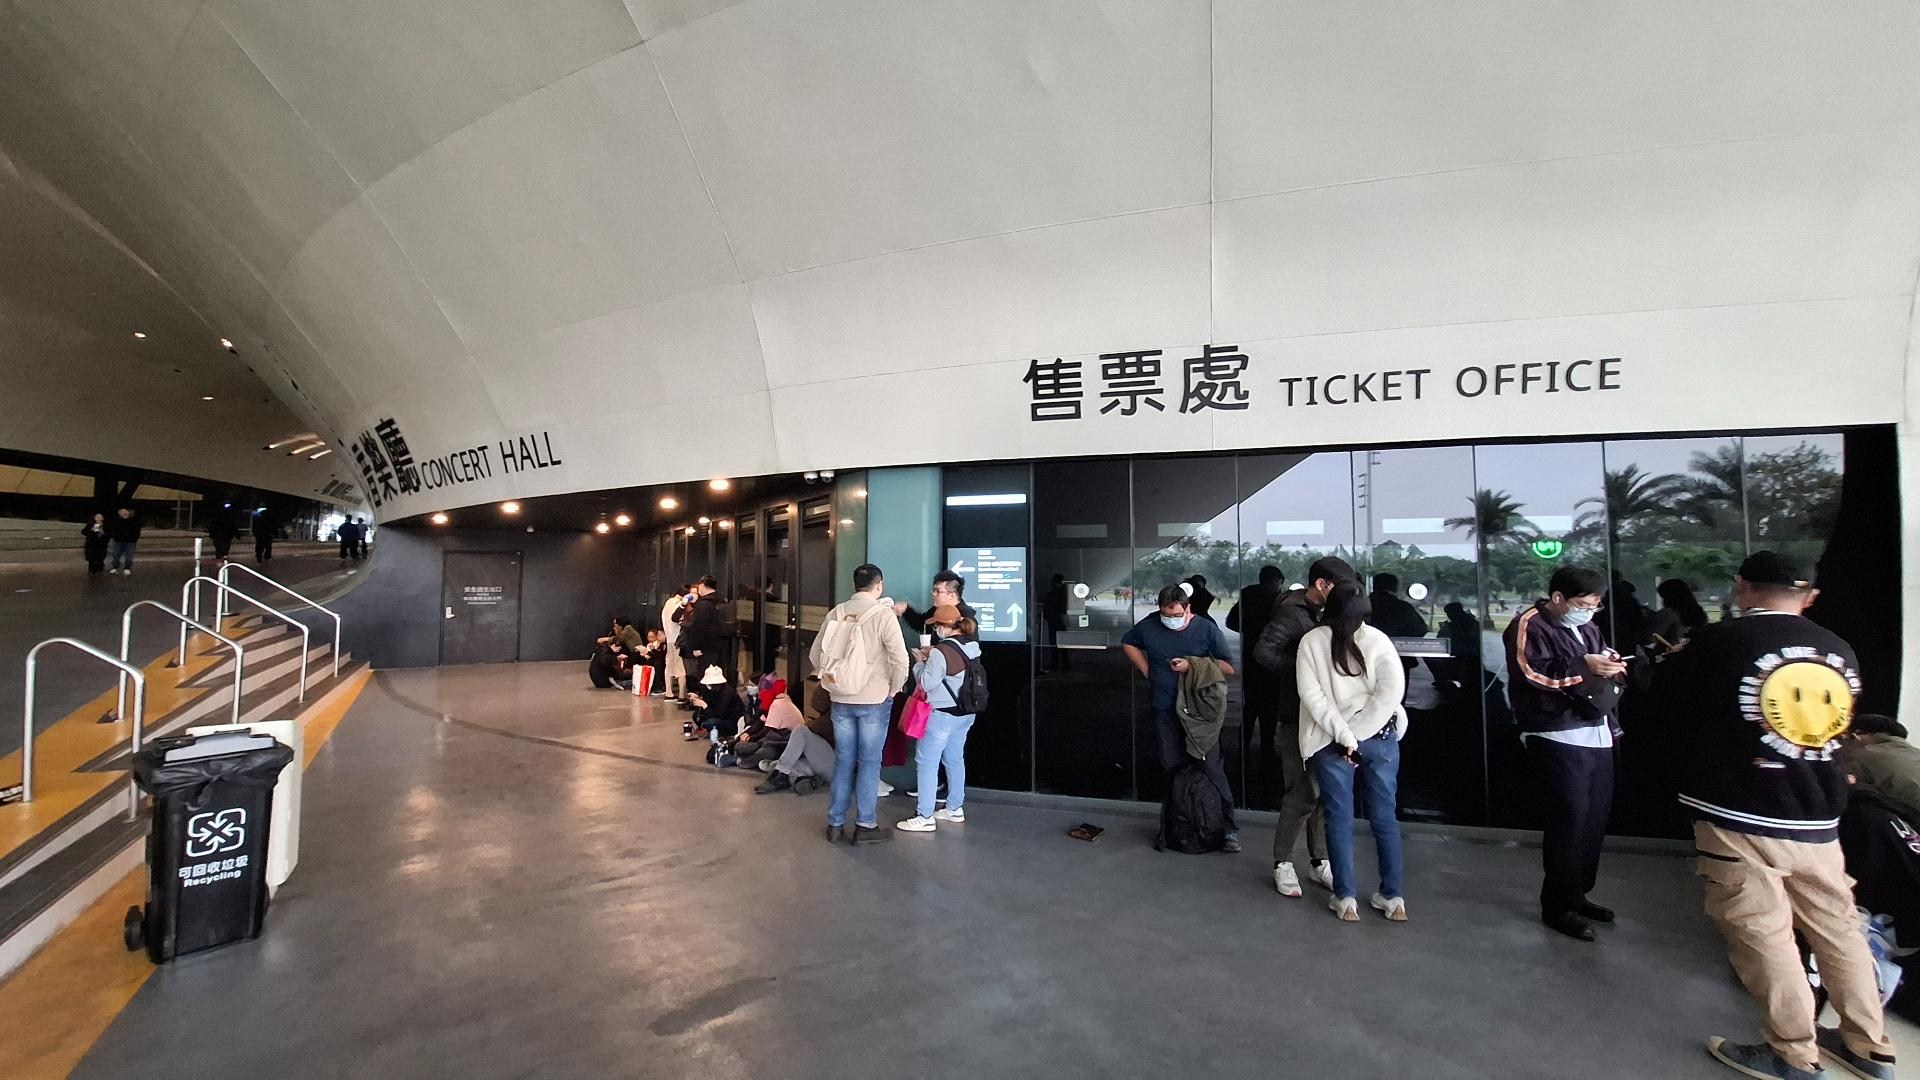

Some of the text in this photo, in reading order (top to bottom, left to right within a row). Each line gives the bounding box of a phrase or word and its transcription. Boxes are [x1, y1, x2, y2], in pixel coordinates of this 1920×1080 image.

[1023, 344, 1249, 421] 售票處
[1280, 358, 1621, 406] TICKET OFFICE
[421, 431, 562, 490] CONCERT HALL
[178, 855, 249, 879] 可回收垃圾
[184, 870, 242, 888] Recycling
